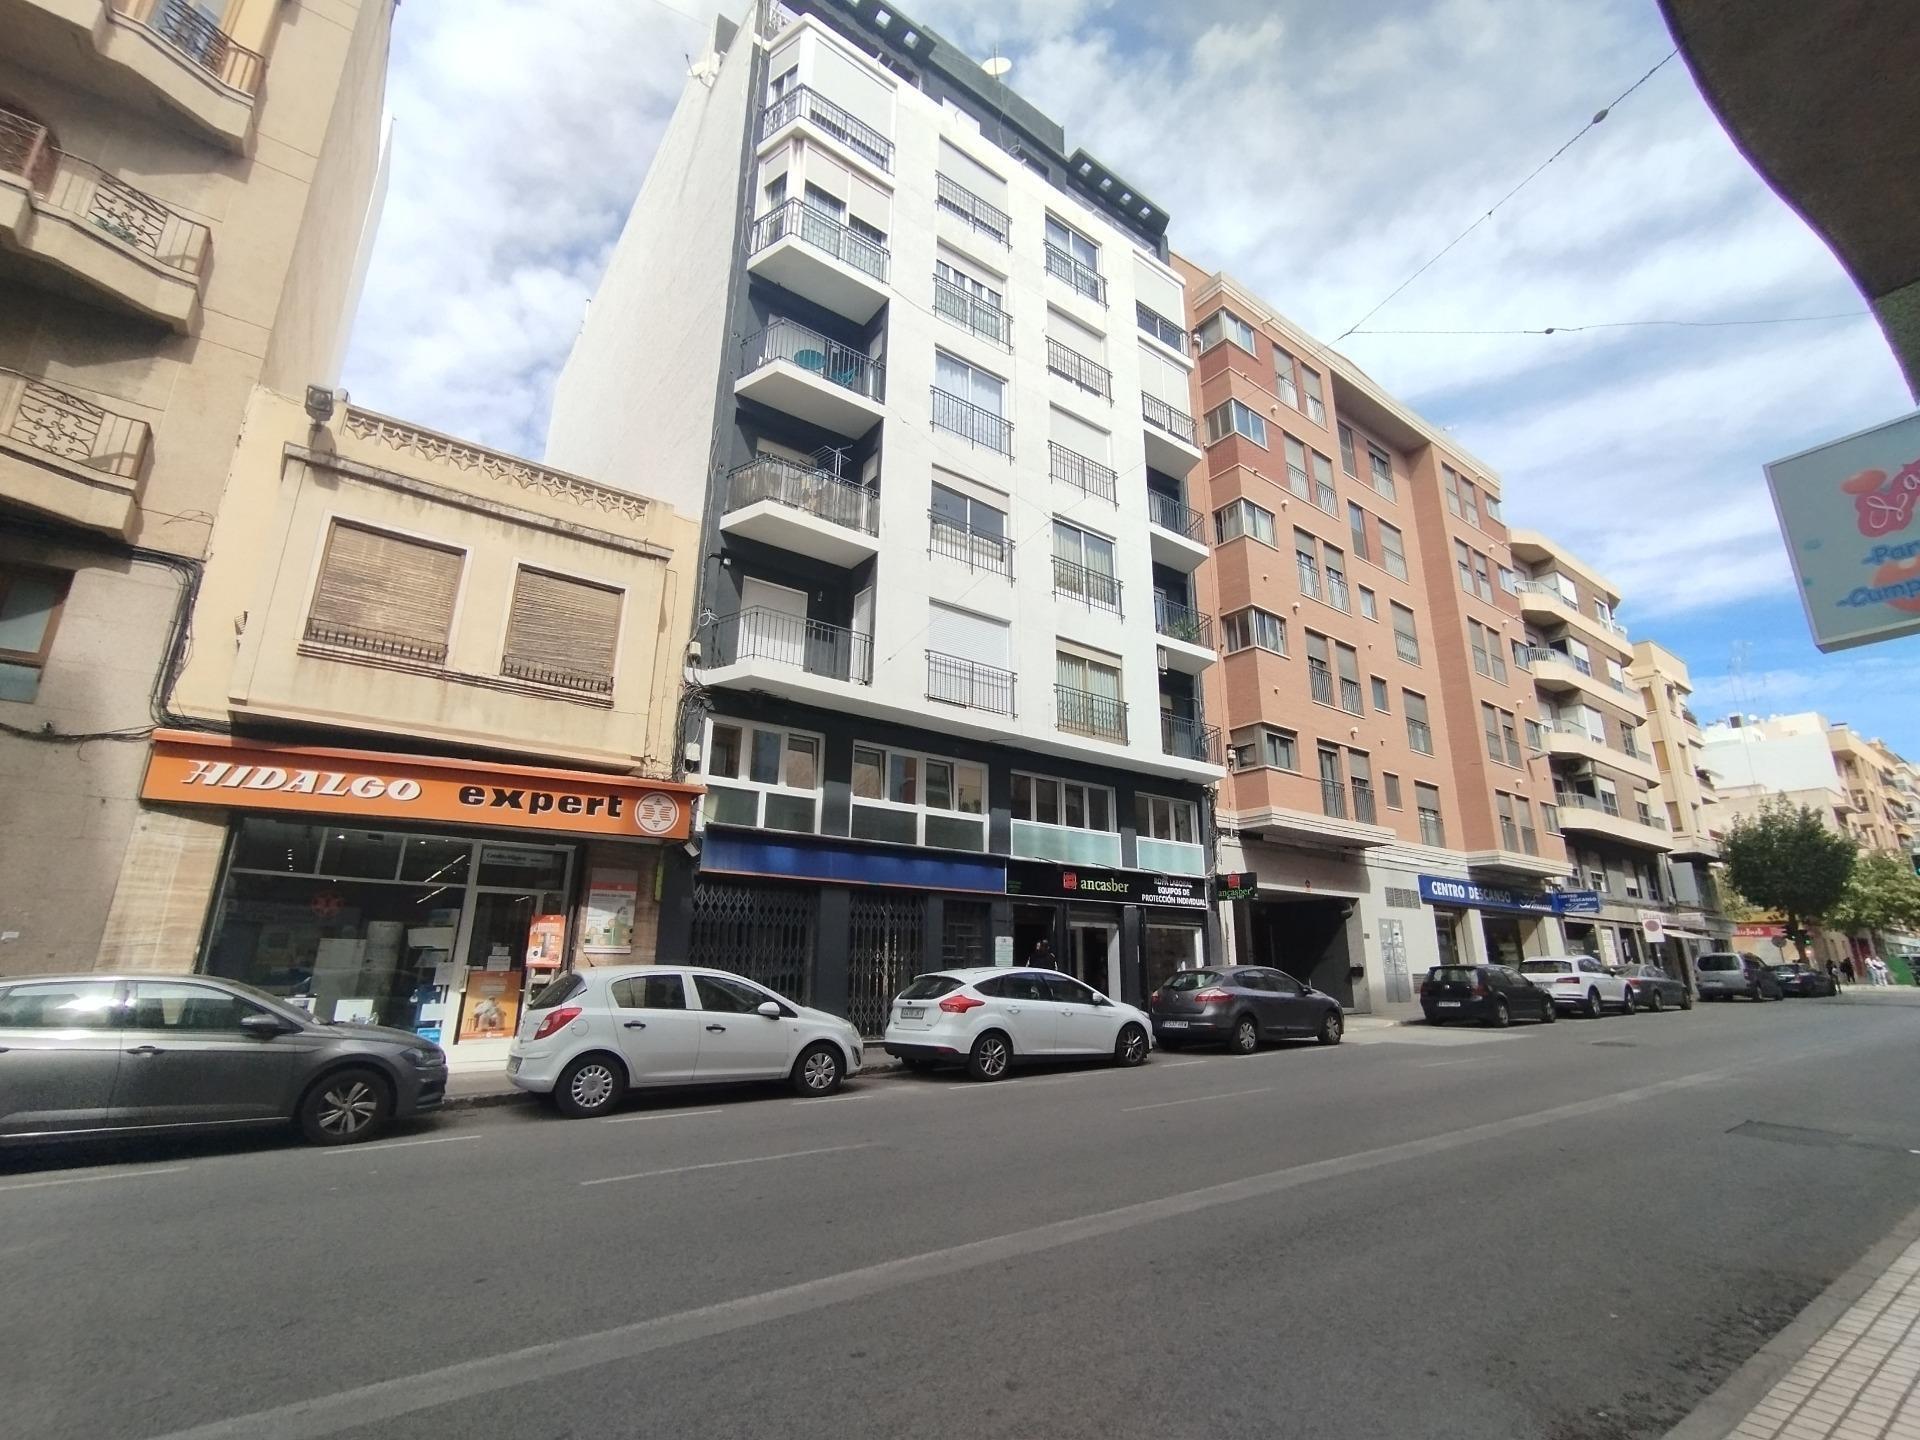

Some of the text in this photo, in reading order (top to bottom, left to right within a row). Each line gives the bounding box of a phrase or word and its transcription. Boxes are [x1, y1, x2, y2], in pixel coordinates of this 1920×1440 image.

[180, 759, 624, 819] HIDALGO expert
[1080, 877, 1130, 893] ancasber
[1157, 886, 1191, 897] EQUIPOS DE
[1431, 881, 1465, 899] CENTRO
[1467, 886, 1511, 904] DESCANSO
[1141, 894, 1206, 906] PROTECCIÓN INDIVIDUAL
